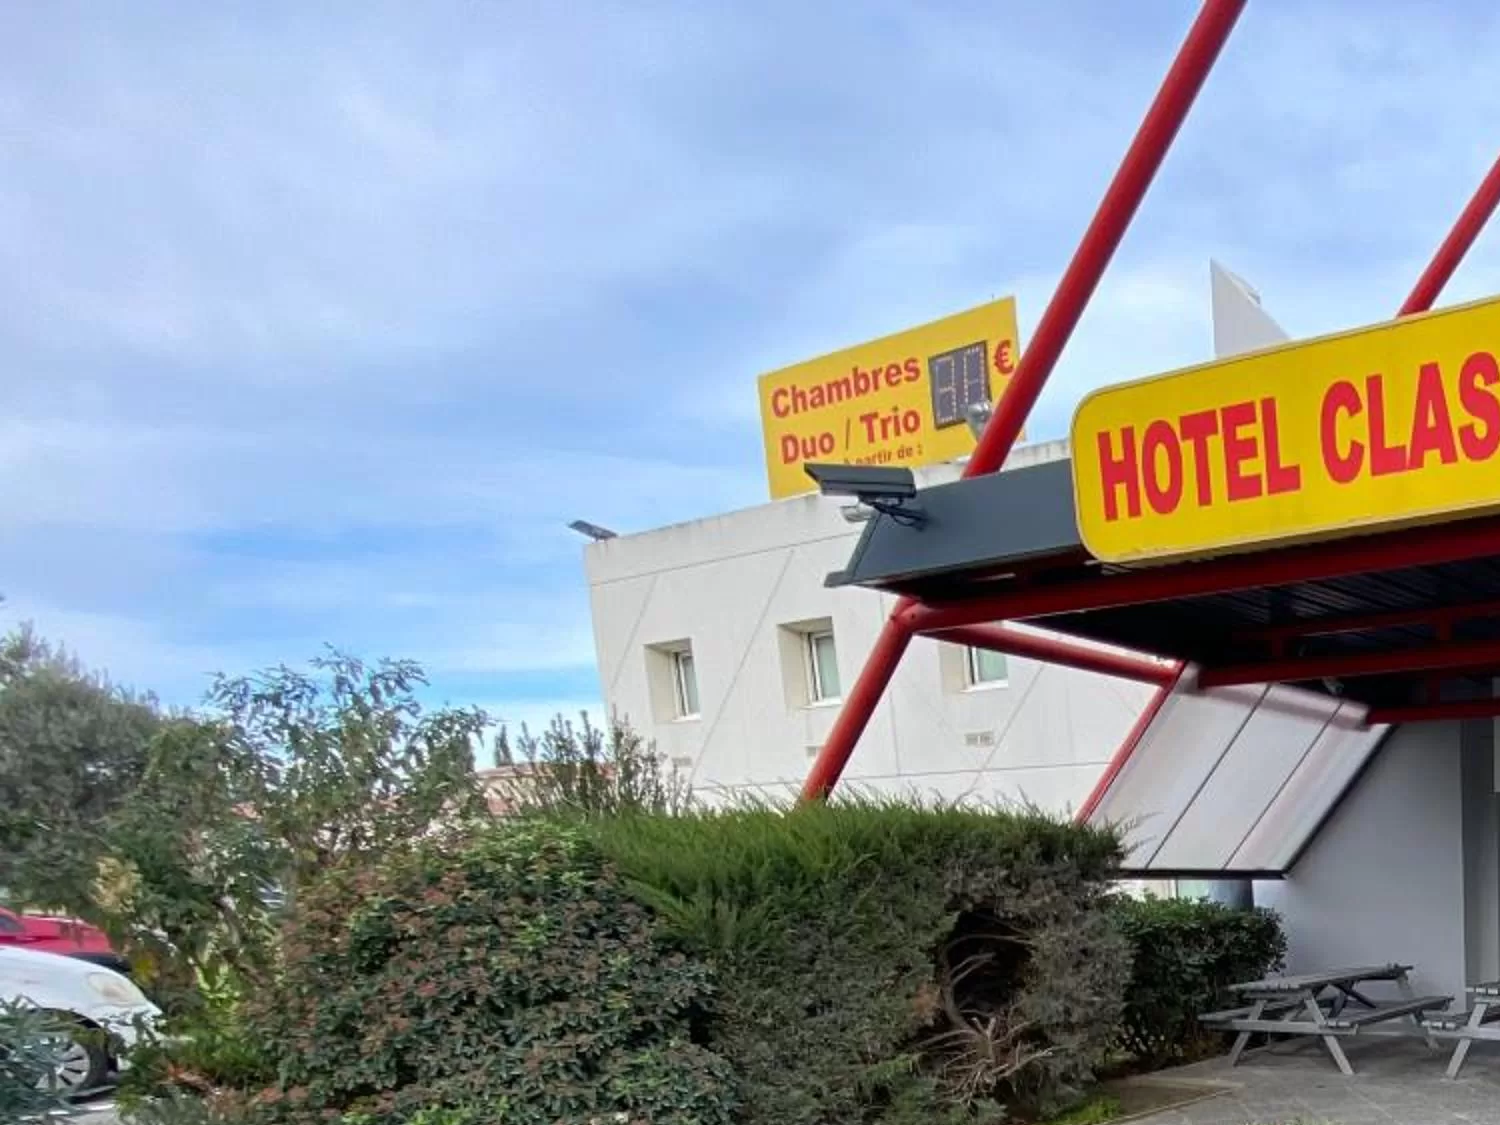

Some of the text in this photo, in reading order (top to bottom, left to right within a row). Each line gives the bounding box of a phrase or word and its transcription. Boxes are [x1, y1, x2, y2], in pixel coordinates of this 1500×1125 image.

[770, 356, 922, 419] Chambres
[779, 431, 836, 465] Duo
[859, 405, 921, 444] Trio
[1097, 396, 1301, 523] HOTEL
